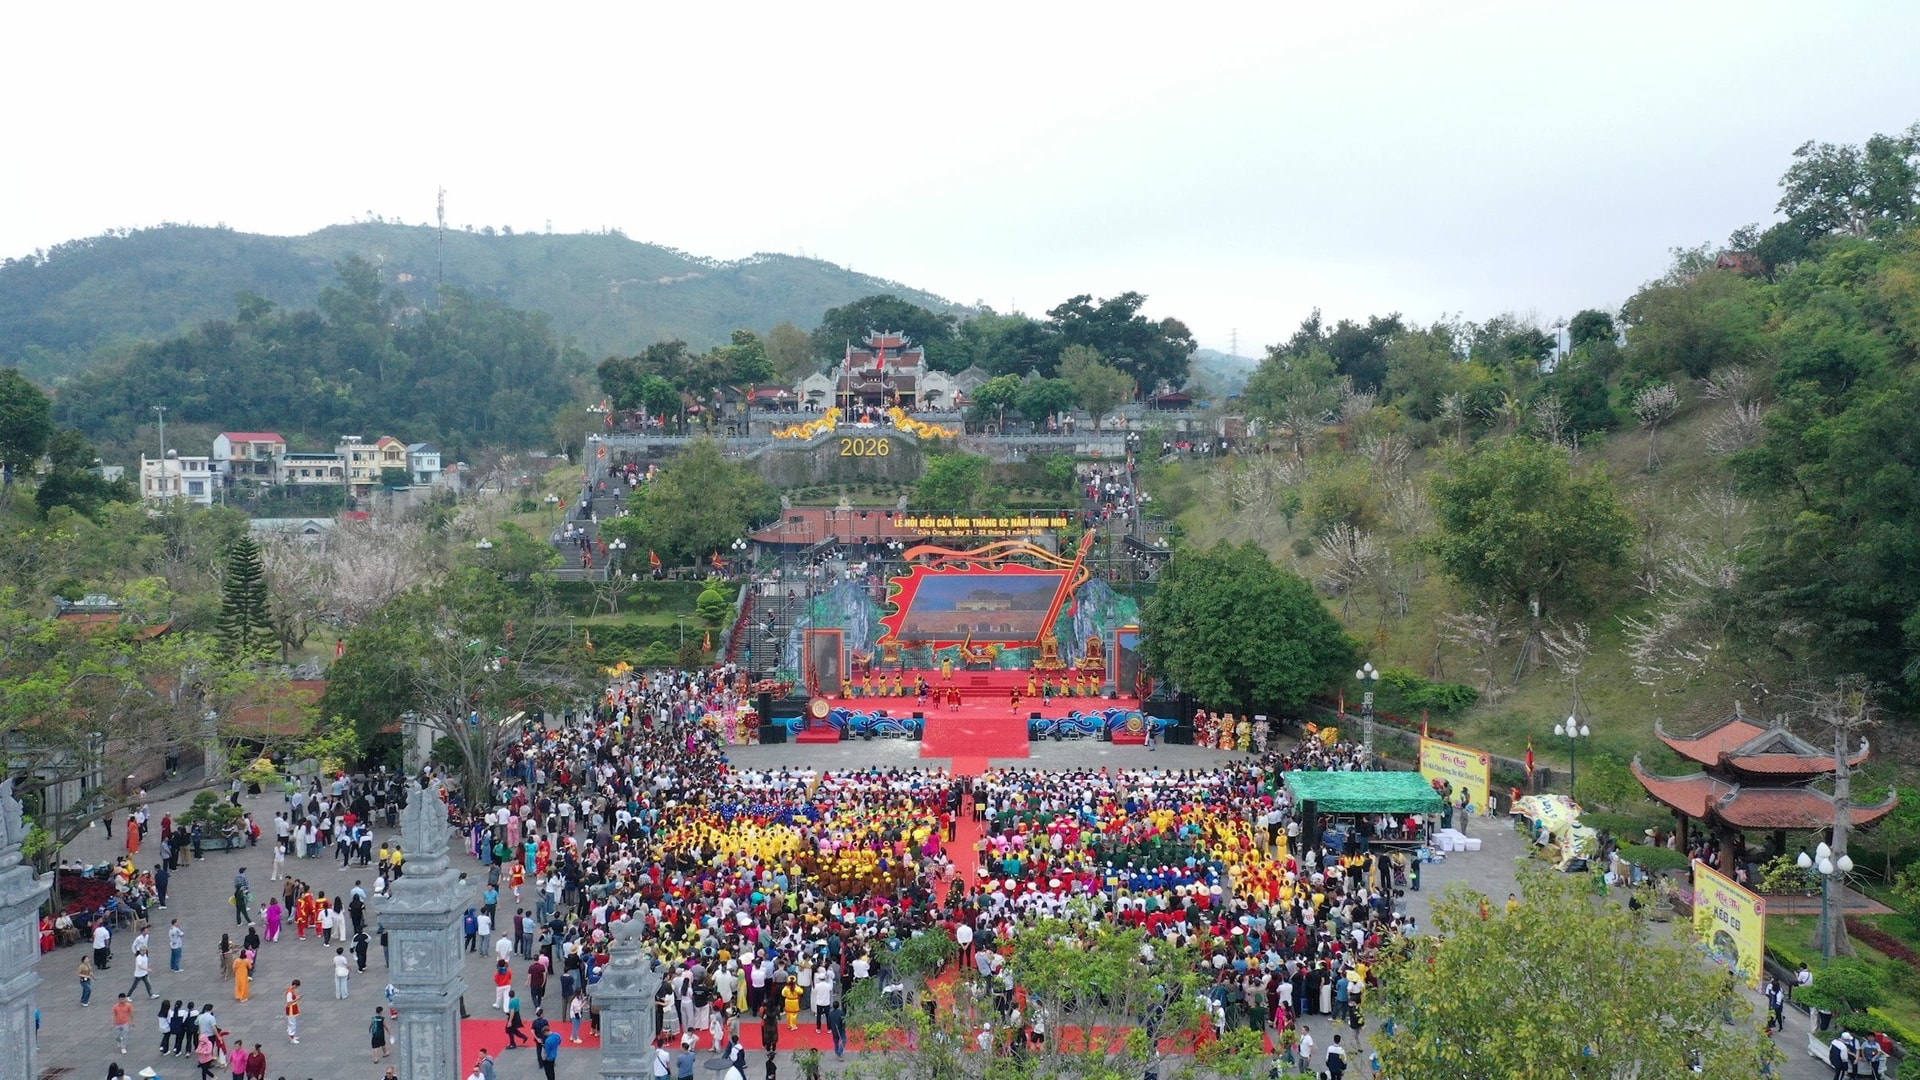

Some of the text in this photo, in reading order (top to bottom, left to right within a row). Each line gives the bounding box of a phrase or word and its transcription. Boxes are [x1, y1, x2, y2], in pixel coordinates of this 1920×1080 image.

[840, 438, 889, 456] 2026
[894, 514, 903, 527] LỄ
[936, 515, 952, 527] CỬA
[953, 516, 970, 527] ÔNG
[972, 516, 997, 527] THÁNG
[999, 518, 1009, 527] 02
[1010, 516, 1029, 527] NĂM
[1051, 518, 1067, 529] NGỌ
